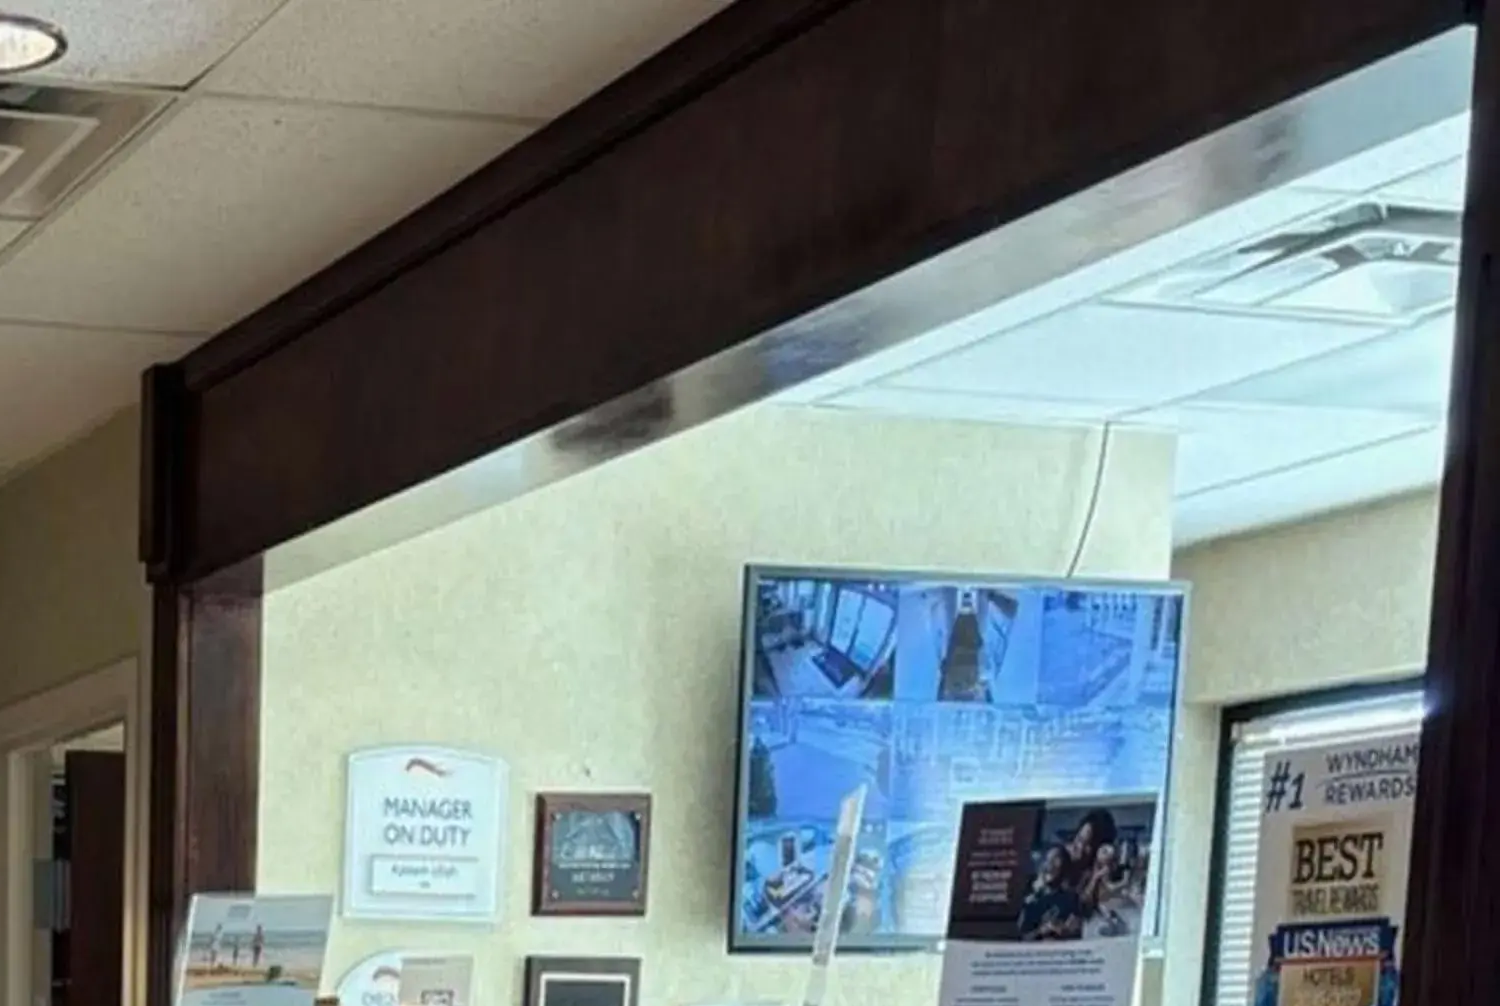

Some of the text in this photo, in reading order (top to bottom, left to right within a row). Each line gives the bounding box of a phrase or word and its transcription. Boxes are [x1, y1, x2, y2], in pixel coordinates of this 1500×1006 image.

[1326, 744, 1419, 773] WYNDHAM
[1266, 761, 1305, 813] #1
[1325, 775, 1415, 805] REWARDS
[383, 797, 473, 820] MANAGER
[384, 822, 471, 846] ON DUTY
[1293, 832, 1384, 885] BEST
